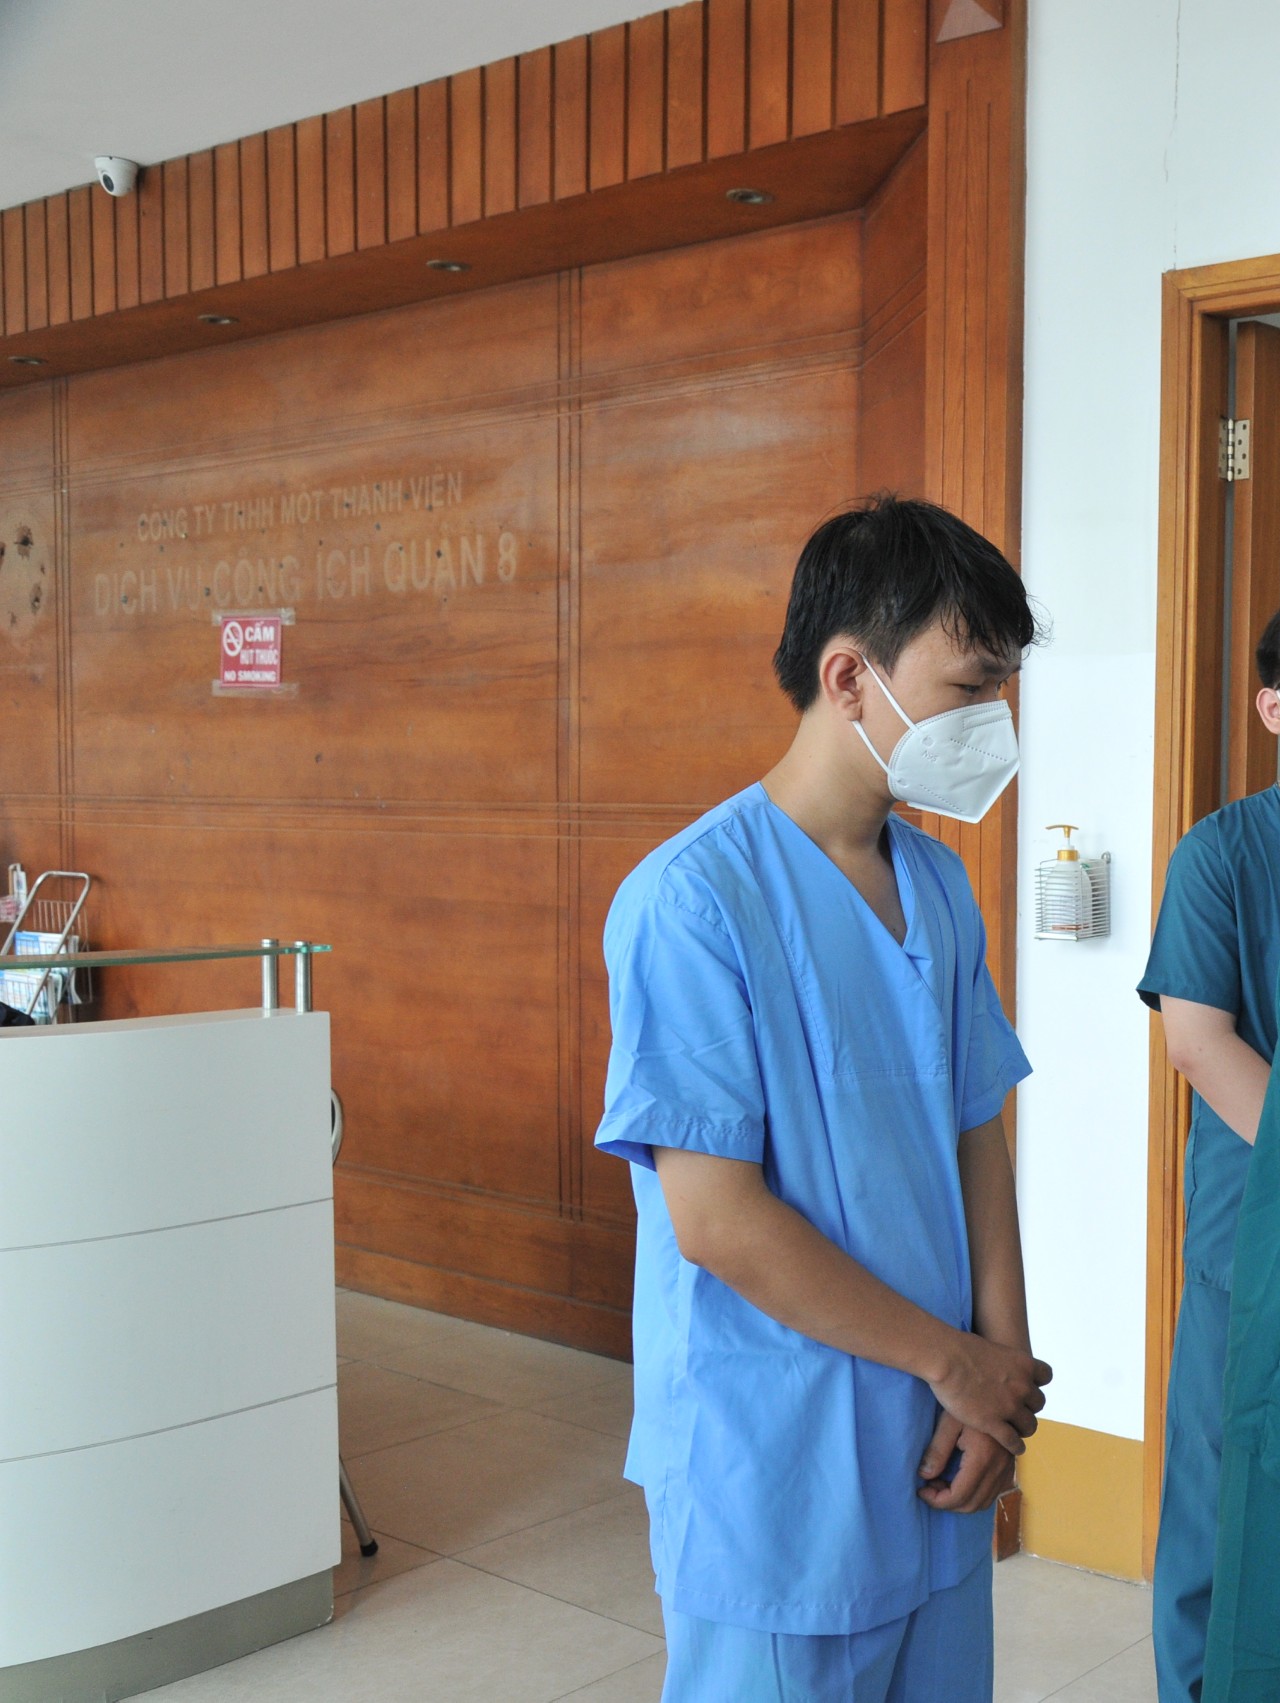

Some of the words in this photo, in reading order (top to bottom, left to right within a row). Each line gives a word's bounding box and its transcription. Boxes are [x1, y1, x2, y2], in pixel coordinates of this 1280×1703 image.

[193, 503, 216, 535] TY
[497, 531, 517, 583] 8
[245, 620, 275, 642] CẤM
[224, 670, 236, 682] NO
[238, 670, 277, 682] SMOKING
